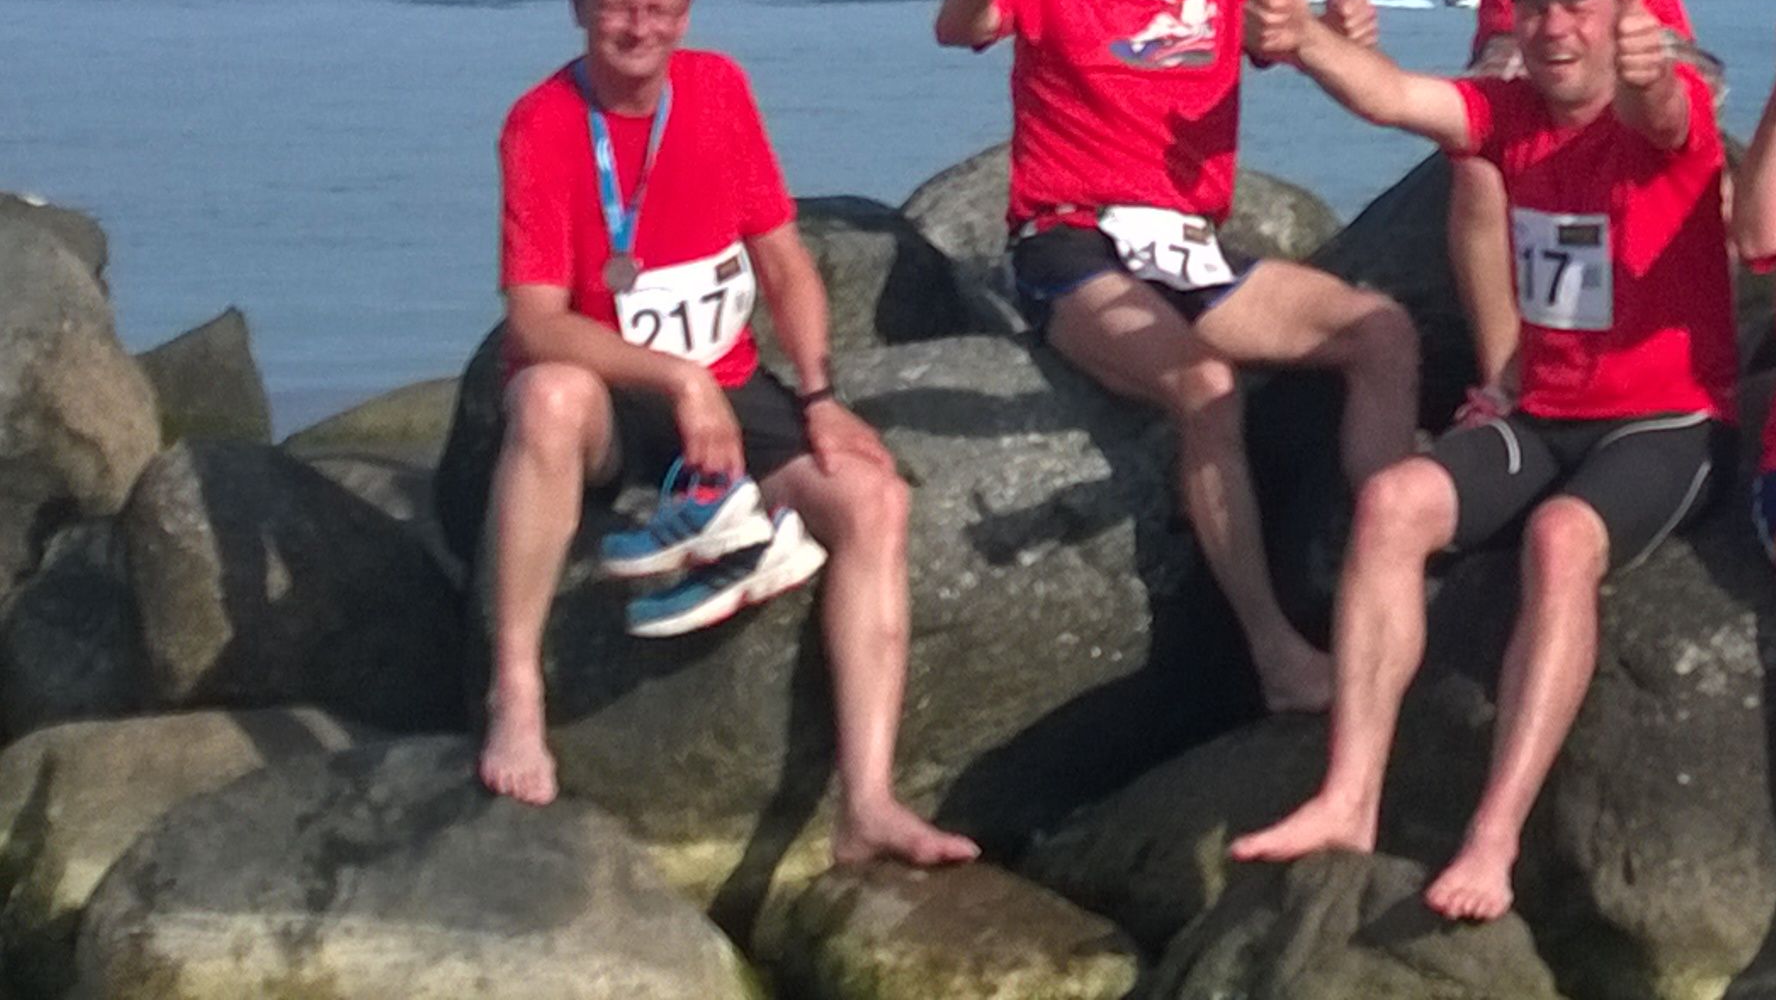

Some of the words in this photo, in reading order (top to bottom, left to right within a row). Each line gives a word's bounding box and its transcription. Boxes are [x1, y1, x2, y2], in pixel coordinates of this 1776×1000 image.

[1130, 241, 1191, 283] 17
[1522, 248, 1570, 307] 17
[631, 287, 729, 352] 217
